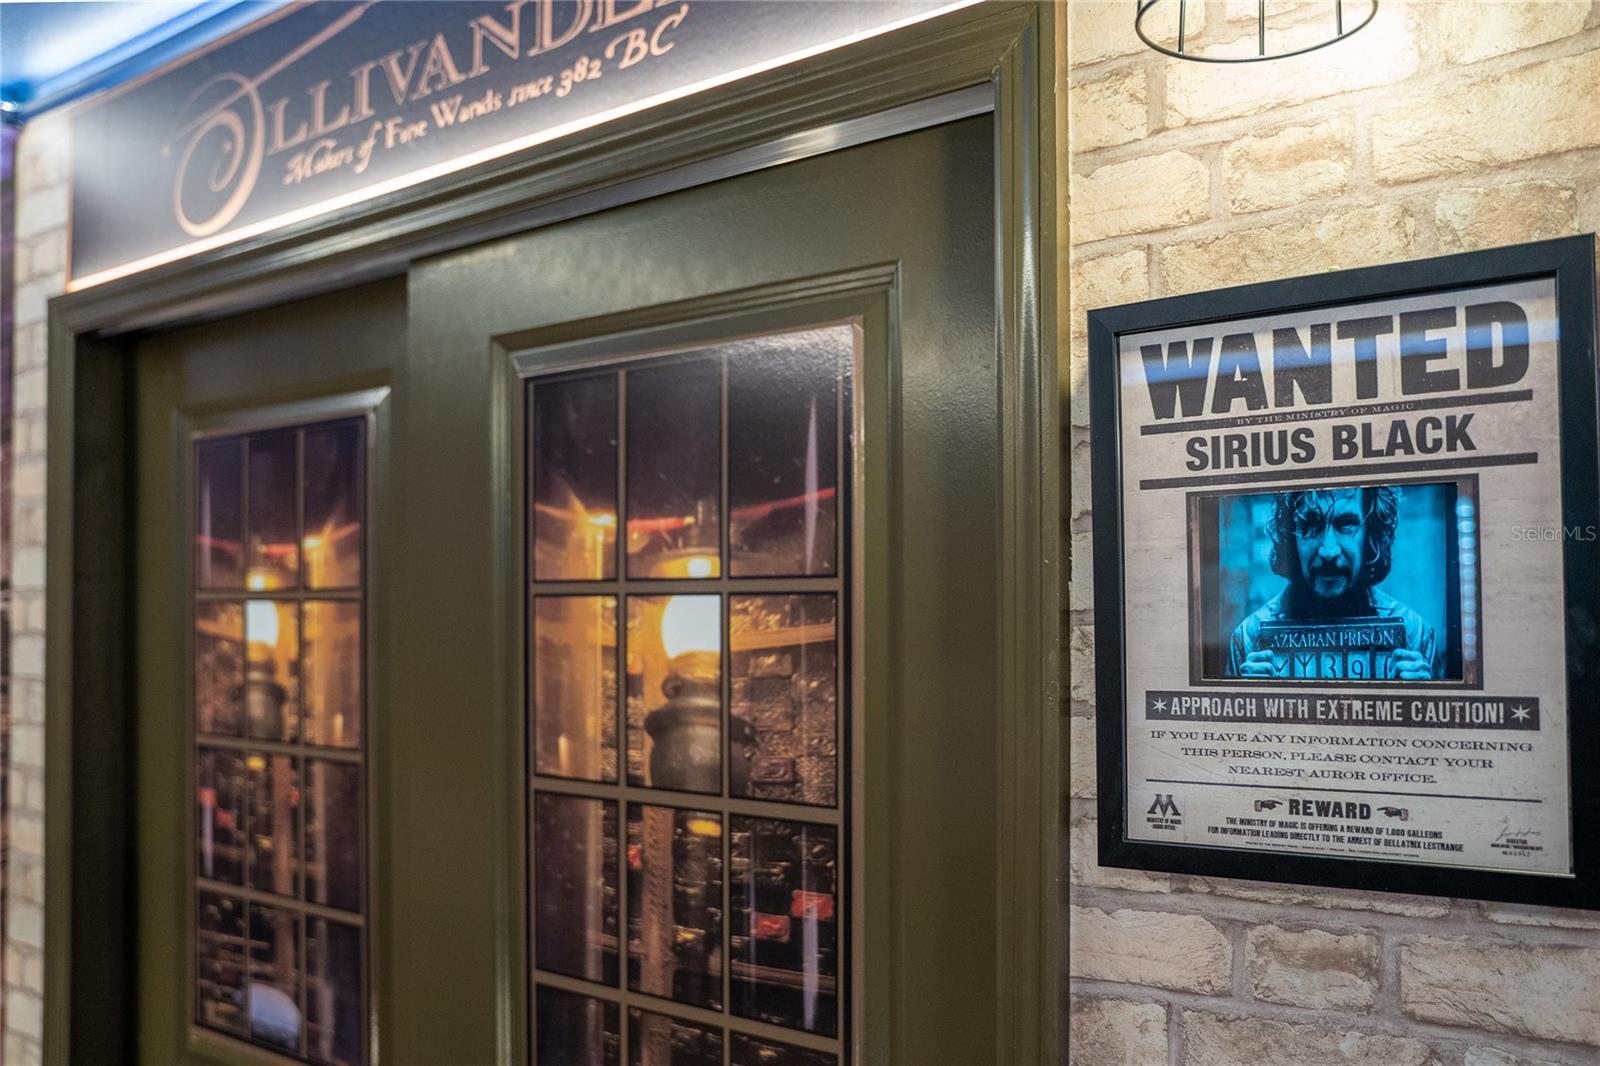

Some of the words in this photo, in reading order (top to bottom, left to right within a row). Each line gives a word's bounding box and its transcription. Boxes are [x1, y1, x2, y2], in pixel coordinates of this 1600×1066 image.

[353, 121, 382, 174] of
[384, 116, 428, 149] Fine
[430, 88, 503, 129] Wands
[507, 74, 554, 107] since
[555, 55, 603, 98] 382
[604, 3, 690, 70] BC
[1139, 301, 1531, 421] WANTED
[1237, 417, 1252, 425] BY
[1285, 409, 1347, 421] MINISTRY
[1351, 406, 1368, 414] OF
[1371, 403, 1415, 413] MAGIC
[1185, 425, 1316, 472] SIRIUS
[1332, 413, 1477, 461] BLACK
[1271, 631, 1336, 648] AZKABAN
[1340, 629, 1394, 647] PRISON
[1170, 696, 1257, 717] APPROACH
[1263, 698, 1309, 719] WITH
[1316, 699, 1403, 721] EXTREME
[1411, 701, 1505, 724] CAUTION!
[1151, 730, 1166, 739] IF
[1169, 731, 1200, 740] YOU
[1203, 732, 1248, 742] HAVE
[1250, 734, 1287, 743] ANY
[1290, 735, 1408, 748] INFORMATION
[1411, 739, 1534, 752] CONCERNING
[1181, 747, 1219, 756] THIS
[1290, 752, 1356, 763] PLEASE
[1359, 754, 1440, 767] CONTACT
[1443, 758, 1494, 768] YOUR
[1228, 765, 1305, 777] NEAREST
[1308, 769, 1366, 781] AUROR
[1369, 772, 1438, 784] OFFICE.
[1288, 798, 1371, 820] REWARD
[1208, 826, 1219, 834] FOR
[1220, 827, 1260, 838] INFORMATION
[1261, 829, 1289, 839] LEADING
[1290, 831, 1320, 842] DIRECTLY
[1322, 834, 1331, 843] TO
[1332, 835, 1345, 844] THE
[1347, 836, 1372, 846] ARREST
[1373, 838, 1382, 846] OF
[1383, 838, 1422, 849] BELLATRIX
[1423, 841, 1464, 852] LESTRANGE
[1225, 817, 1237, 826] THE
[1239, 818, 1268, 827] MINISTRY
[1269, 820, 1278, 828] OF
[1278, 820, 1299, 830] MAGIC
[1300, 822, 1307, 830] IS
[1308, 822, 1338, 832] OFFERING
[1340, 825, 1345, 833] A
[1346, 825, 1374, 835] REWARD
[1375, 827, 1384, 836] OF
[1407, 829, 1443, 839] GALLEONS
